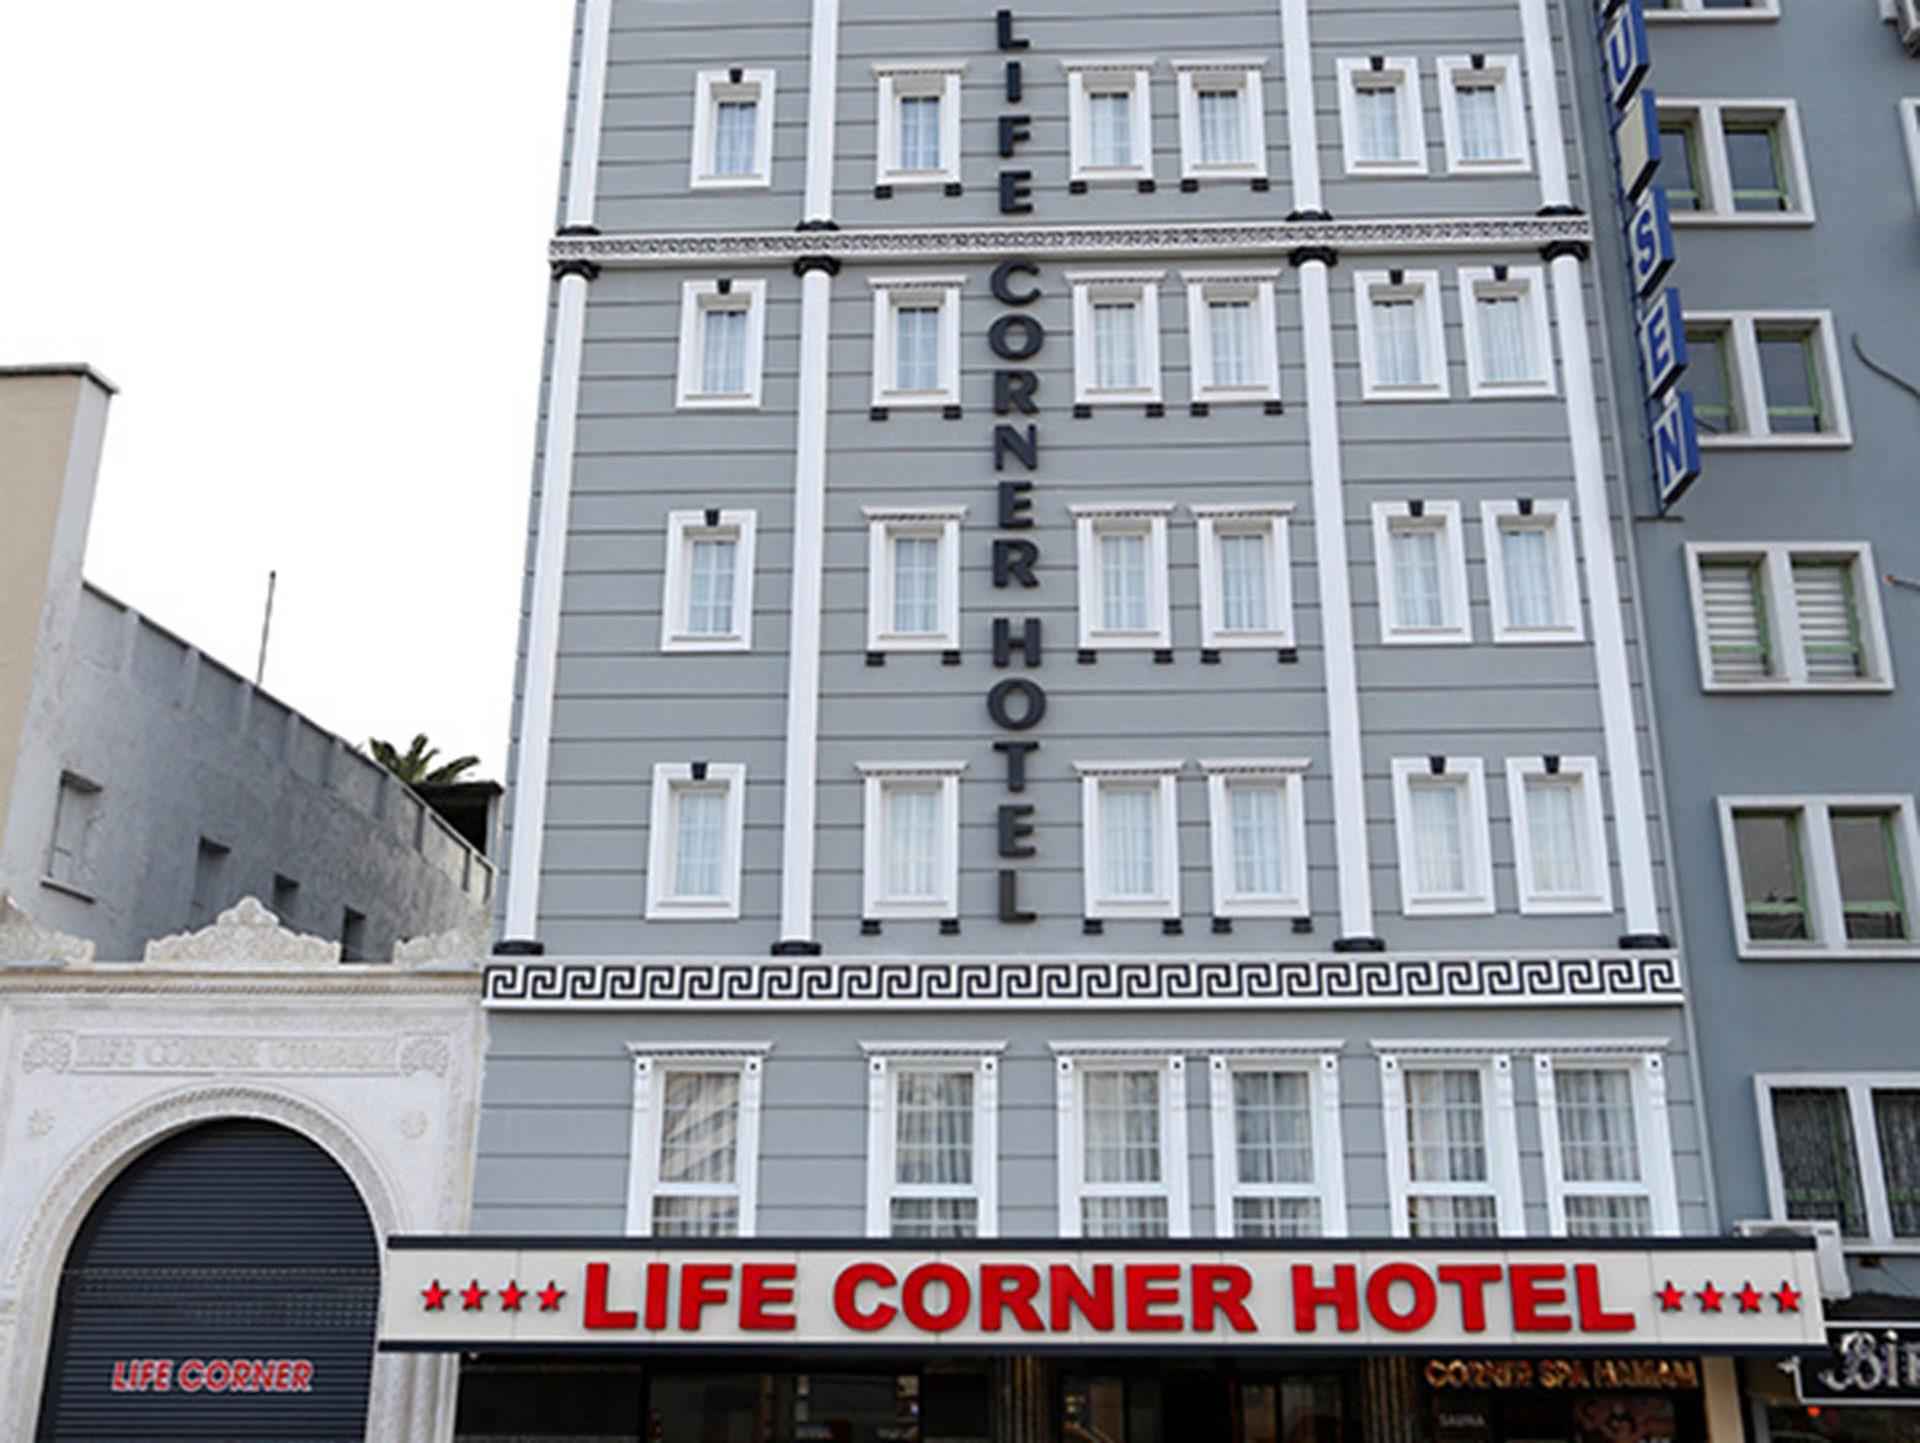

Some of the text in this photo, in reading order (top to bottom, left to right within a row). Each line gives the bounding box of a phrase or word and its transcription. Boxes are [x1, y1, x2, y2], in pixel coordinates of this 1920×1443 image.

[986, 9, 1047, 925] LIFE CORNER HOTEL
[583, 1261, 1637, 1332] LIFE CORNER HOTEL
[111, 1359, 315, 1393] LIFE CORNER
